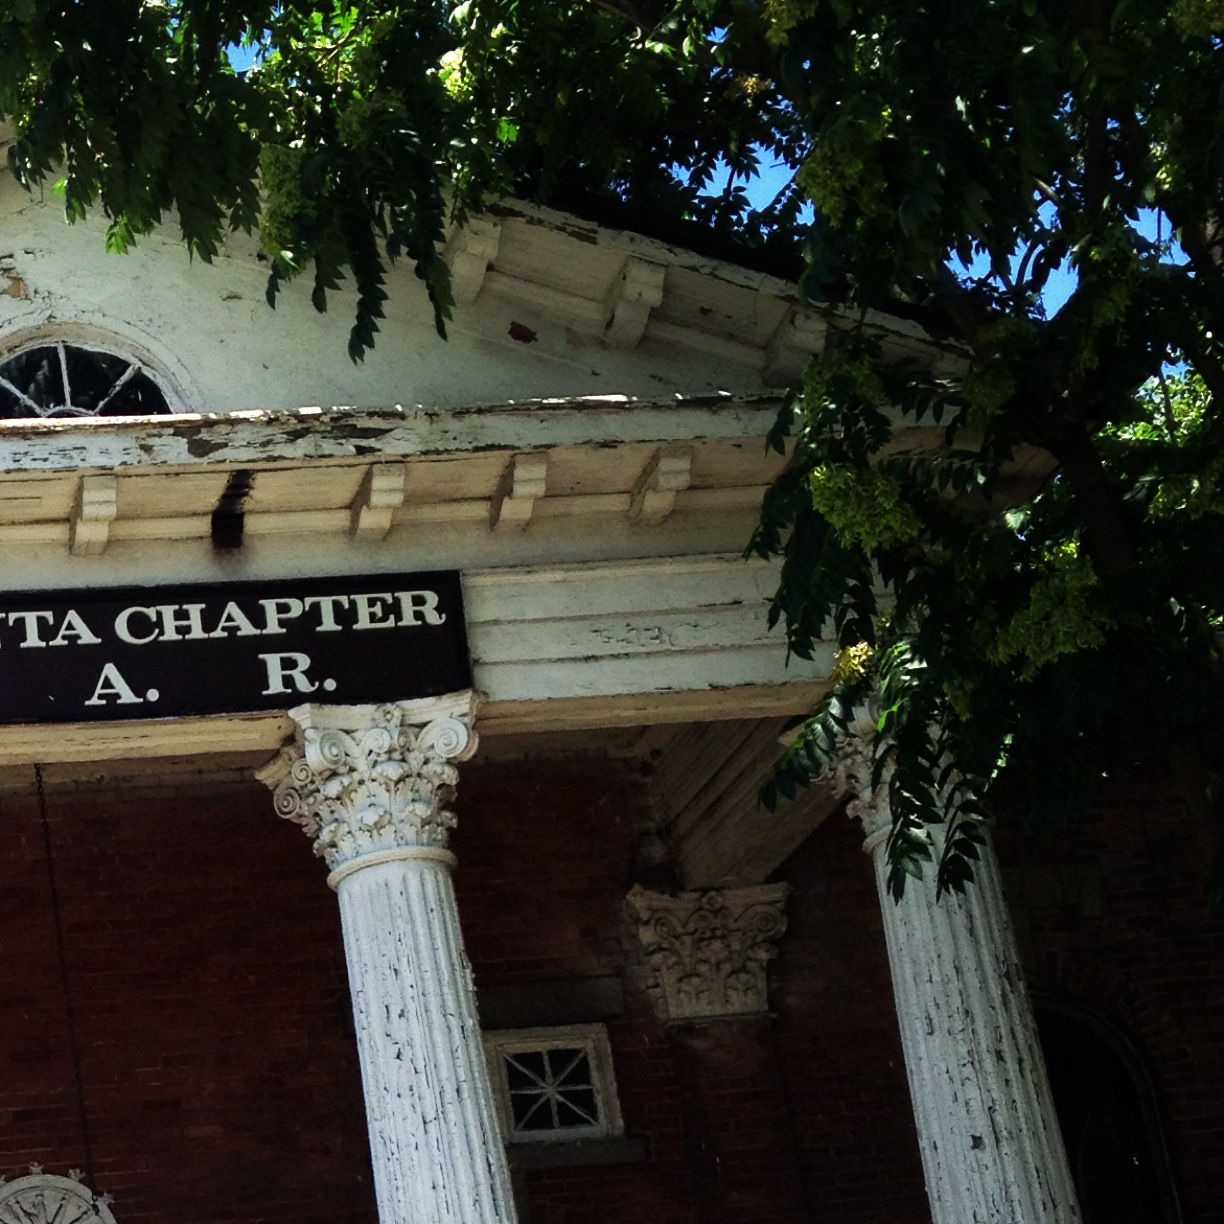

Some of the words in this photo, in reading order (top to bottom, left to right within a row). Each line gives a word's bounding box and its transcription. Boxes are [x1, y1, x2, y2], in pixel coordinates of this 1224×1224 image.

[113, 590, 447, 644] CHAPTER
[84, 662, 161, 707] A.
[256, 652, 338, 696] R.
